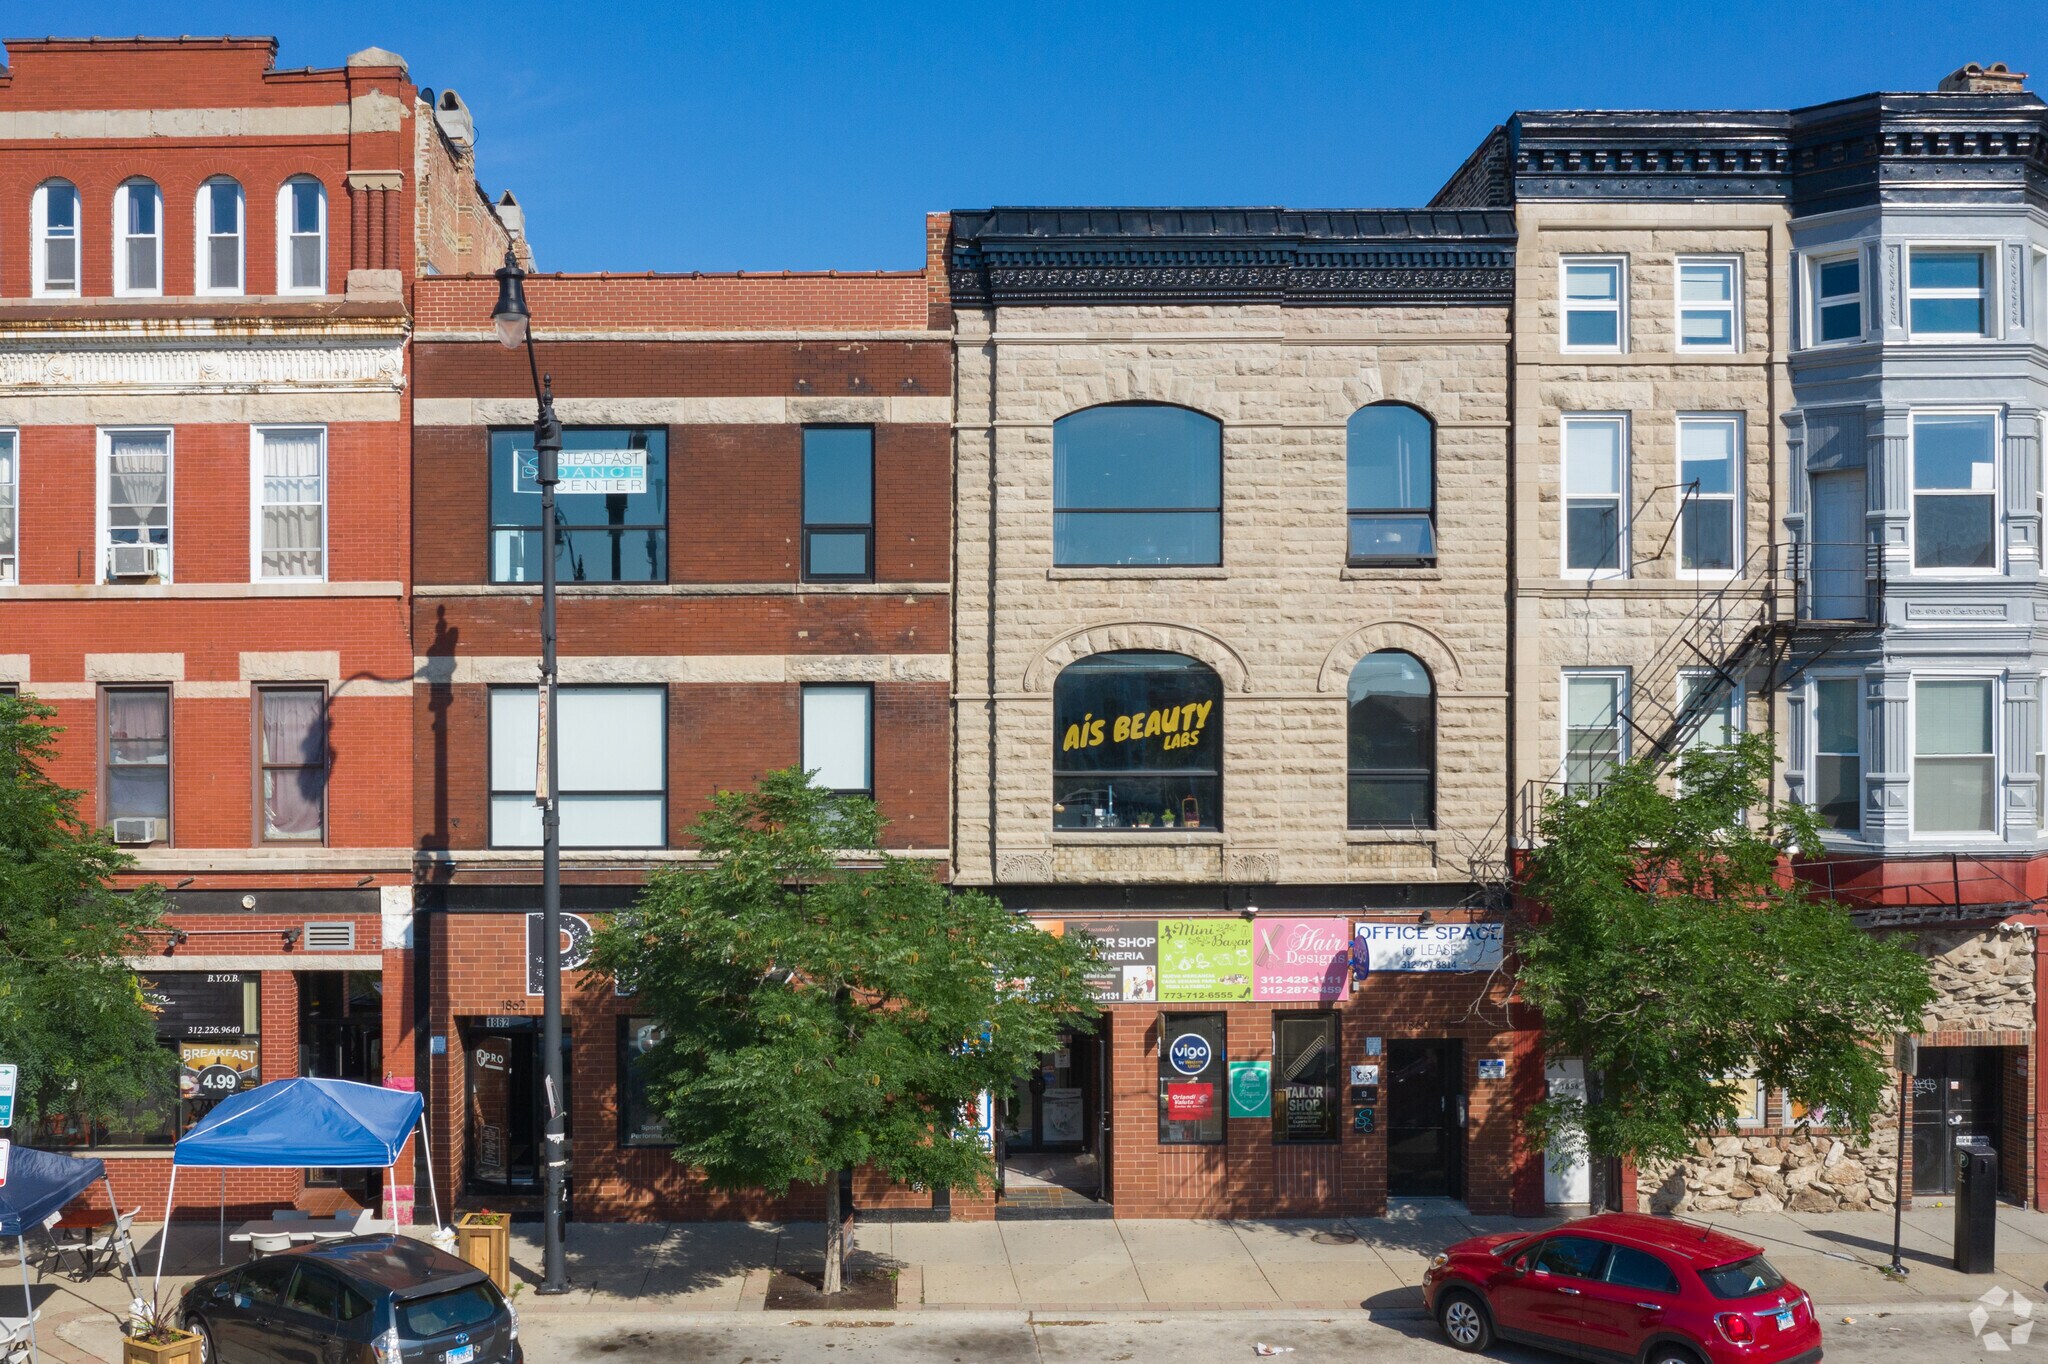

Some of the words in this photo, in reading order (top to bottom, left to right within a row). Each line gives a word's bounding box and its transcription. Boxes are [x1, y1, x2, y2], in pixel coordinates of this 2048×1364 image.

[557, 452, 640, 465] STEADFAST
[558, 466, 643, 478] DANCE
[554, 479, 642, 492] CENTER
[1113, 699, 1213, 743] BEAUTY
[1163, 730, 1200, 751] LABS
[1173, 921, 1215, 936] Mini
[1357, 926, 1429, 940] OFFICE
[1435, 926, 1503, 940] SPACE
[1118, 937, 1156, 948] SHOP
[1211, 933, 1252, 950] Bazar
[1286, 923, 1346, 952] Hair
[1402, 944, 1416, 956] for
[1420, 943, 1457, 956] LEASE
[1285, 950, 1345, 966] Designs
[1401, 960, 1457, 969] 312-767-8814
[207, 974, 240, 983] B.Y.O.B.
[1260, 976, 1341, 984] 312-428-1111
[1164, 991, 1234, 999] 773-712-6555
[1260, 986, 1342, 994] 312-287-9459
[501, 999, 527, 1011] 1862
[487, 1017, 510, 1028] 1862
[187, 1026, 241, 1034] 312.226.9640
[183, 1048, 256, 1064] BREAKFAST
[1175, 1043, 1207, 1060] vigo
[485, 1052, 504, 1064] PRO
[202, 1073, 236, 1090] 4.99
[1286, 1086, 1324, 1098] TAILOR
[1288, 1099, 1321, 1111] SHOP
